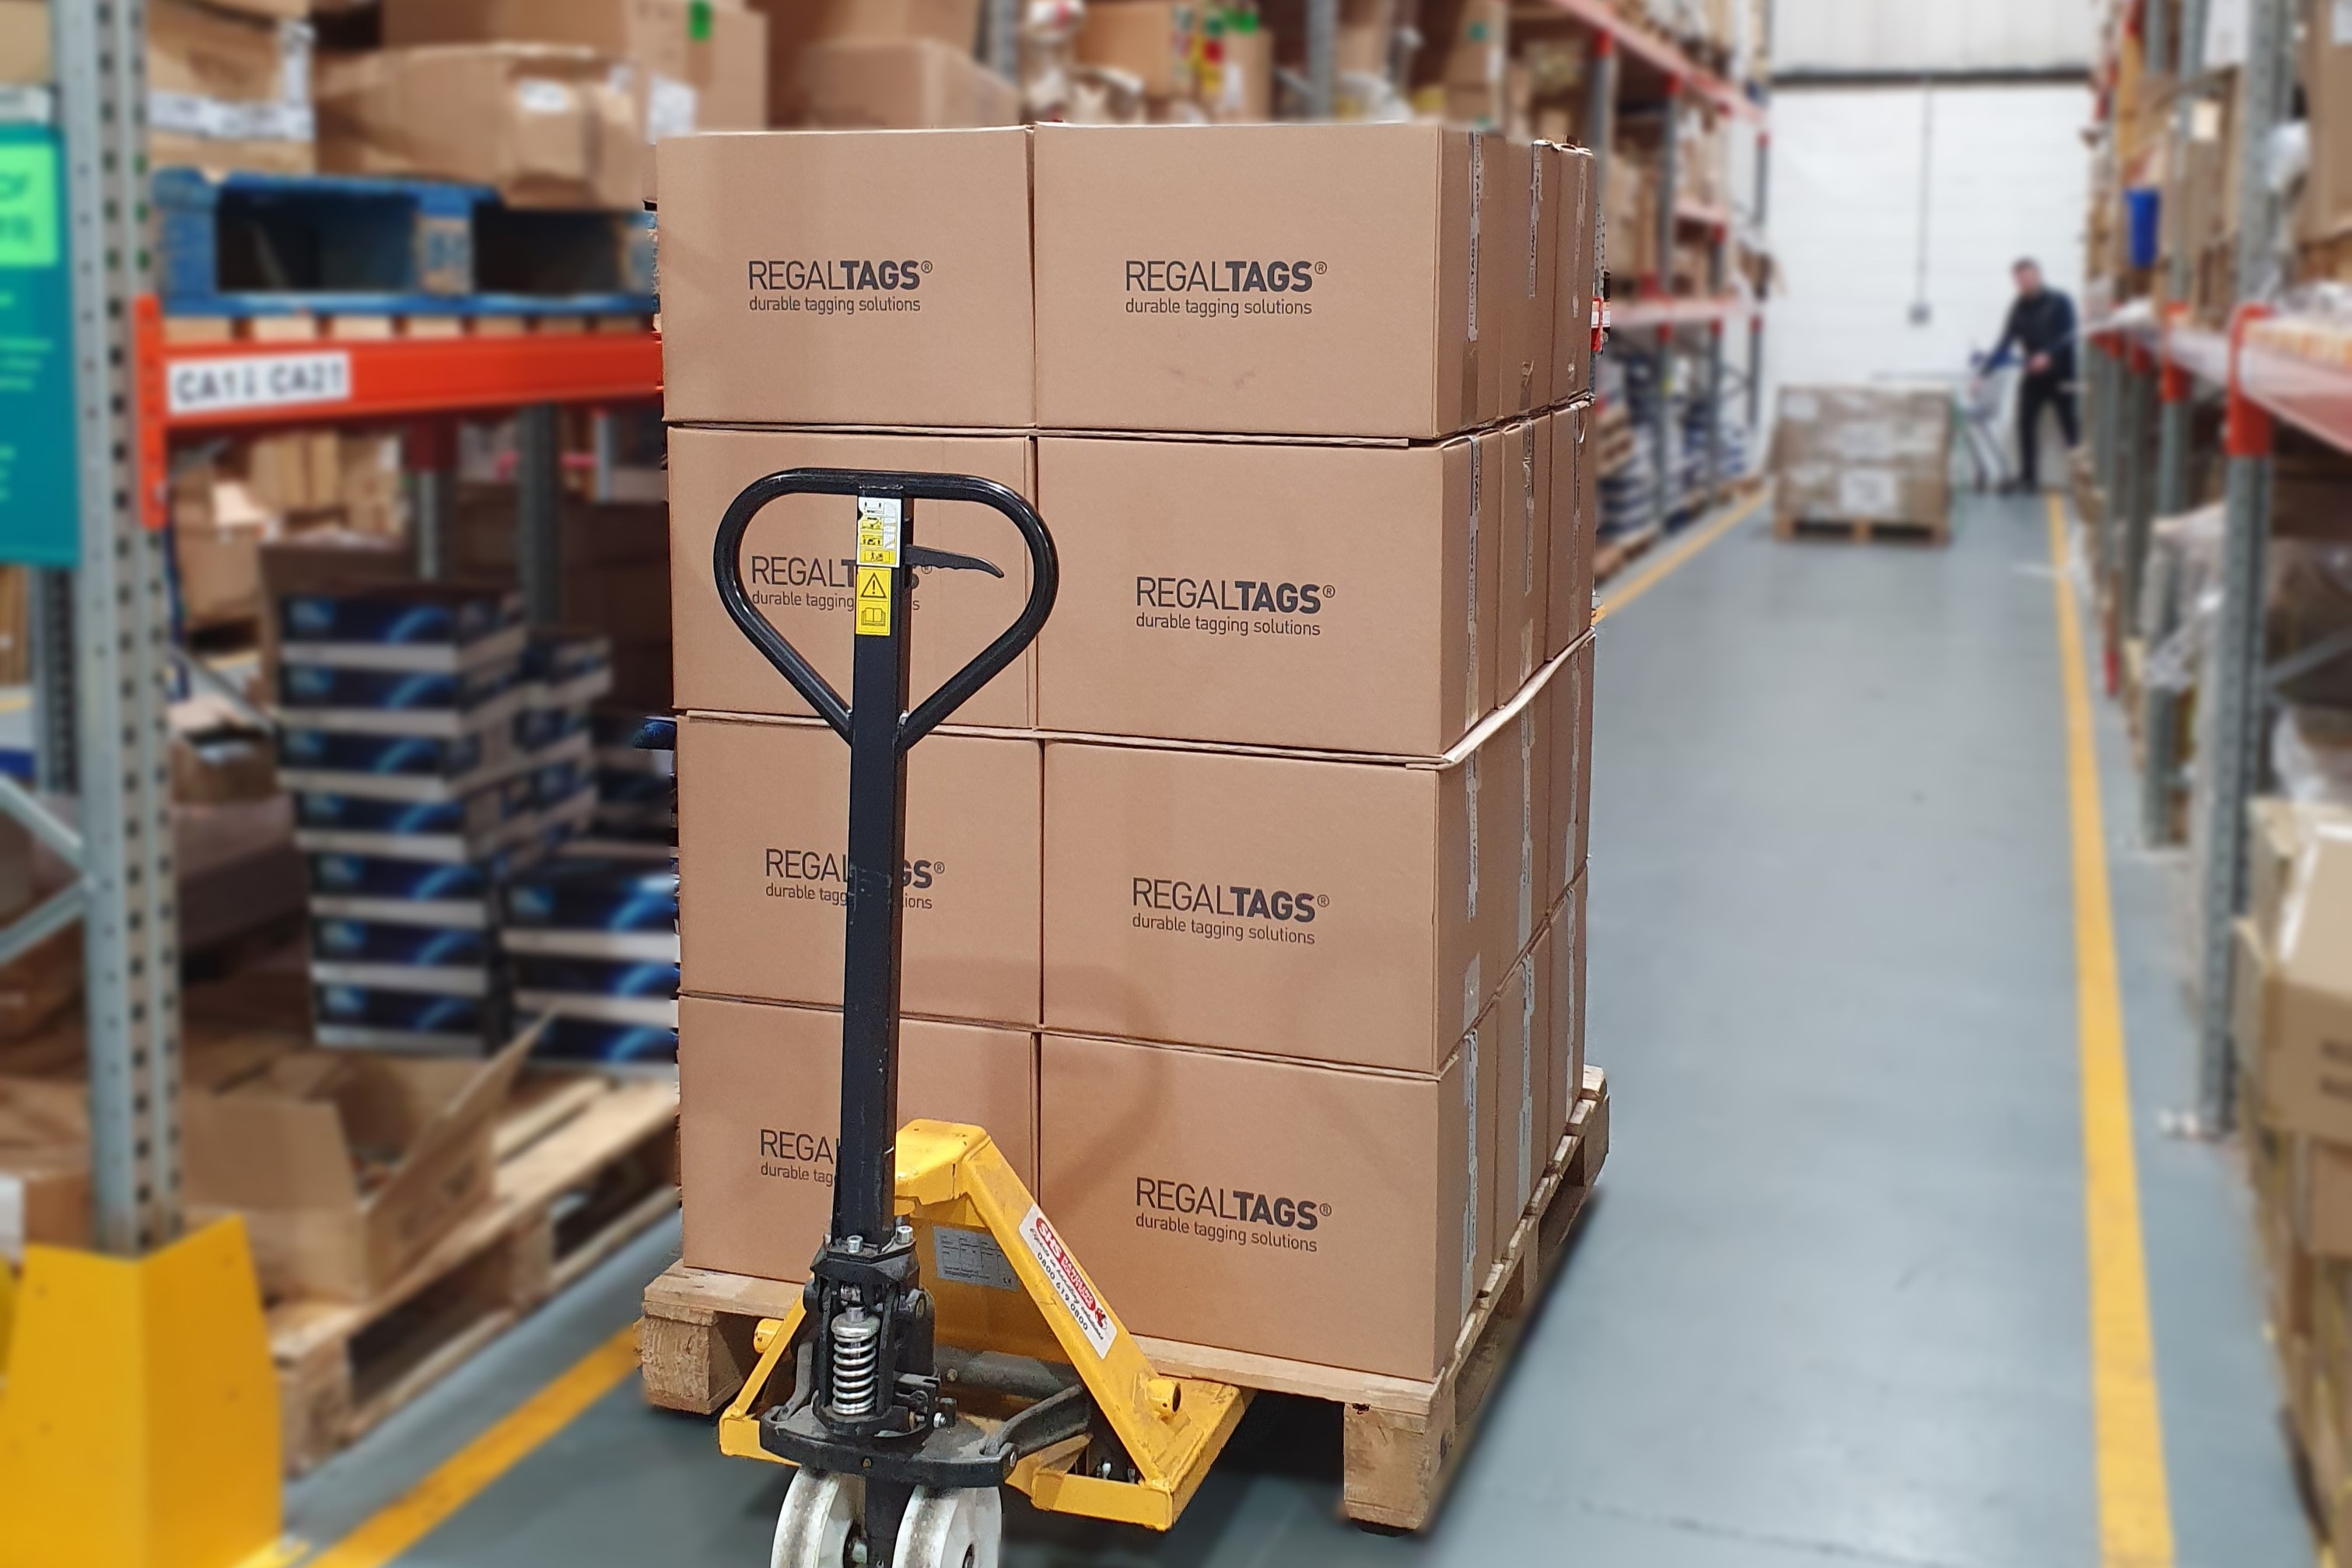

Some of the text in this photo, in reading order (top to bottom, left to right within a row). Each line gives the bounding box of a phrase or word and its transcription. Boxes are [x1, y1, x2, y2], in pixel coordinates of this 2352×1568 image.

[749, 296, 921, 315] durable tagging solutions
[1125, 297, 1313, 318] durable tagging solutions
[752, 590, 855, 612] durable tagging
[1136, 612, 1321, 636] durable tagging solutions
[765, 882, 816, 900] durable
[1132, 912, 1316, 946] durable tagging solutions
[761, 1161, 810, 1181] durable
[1038, 1222, 1062, 1258] SHS
[1136, 1213, 1318, 1253] durable tagging solutions
[1038, 1252, 1089, 1331] 0800 619 0800
